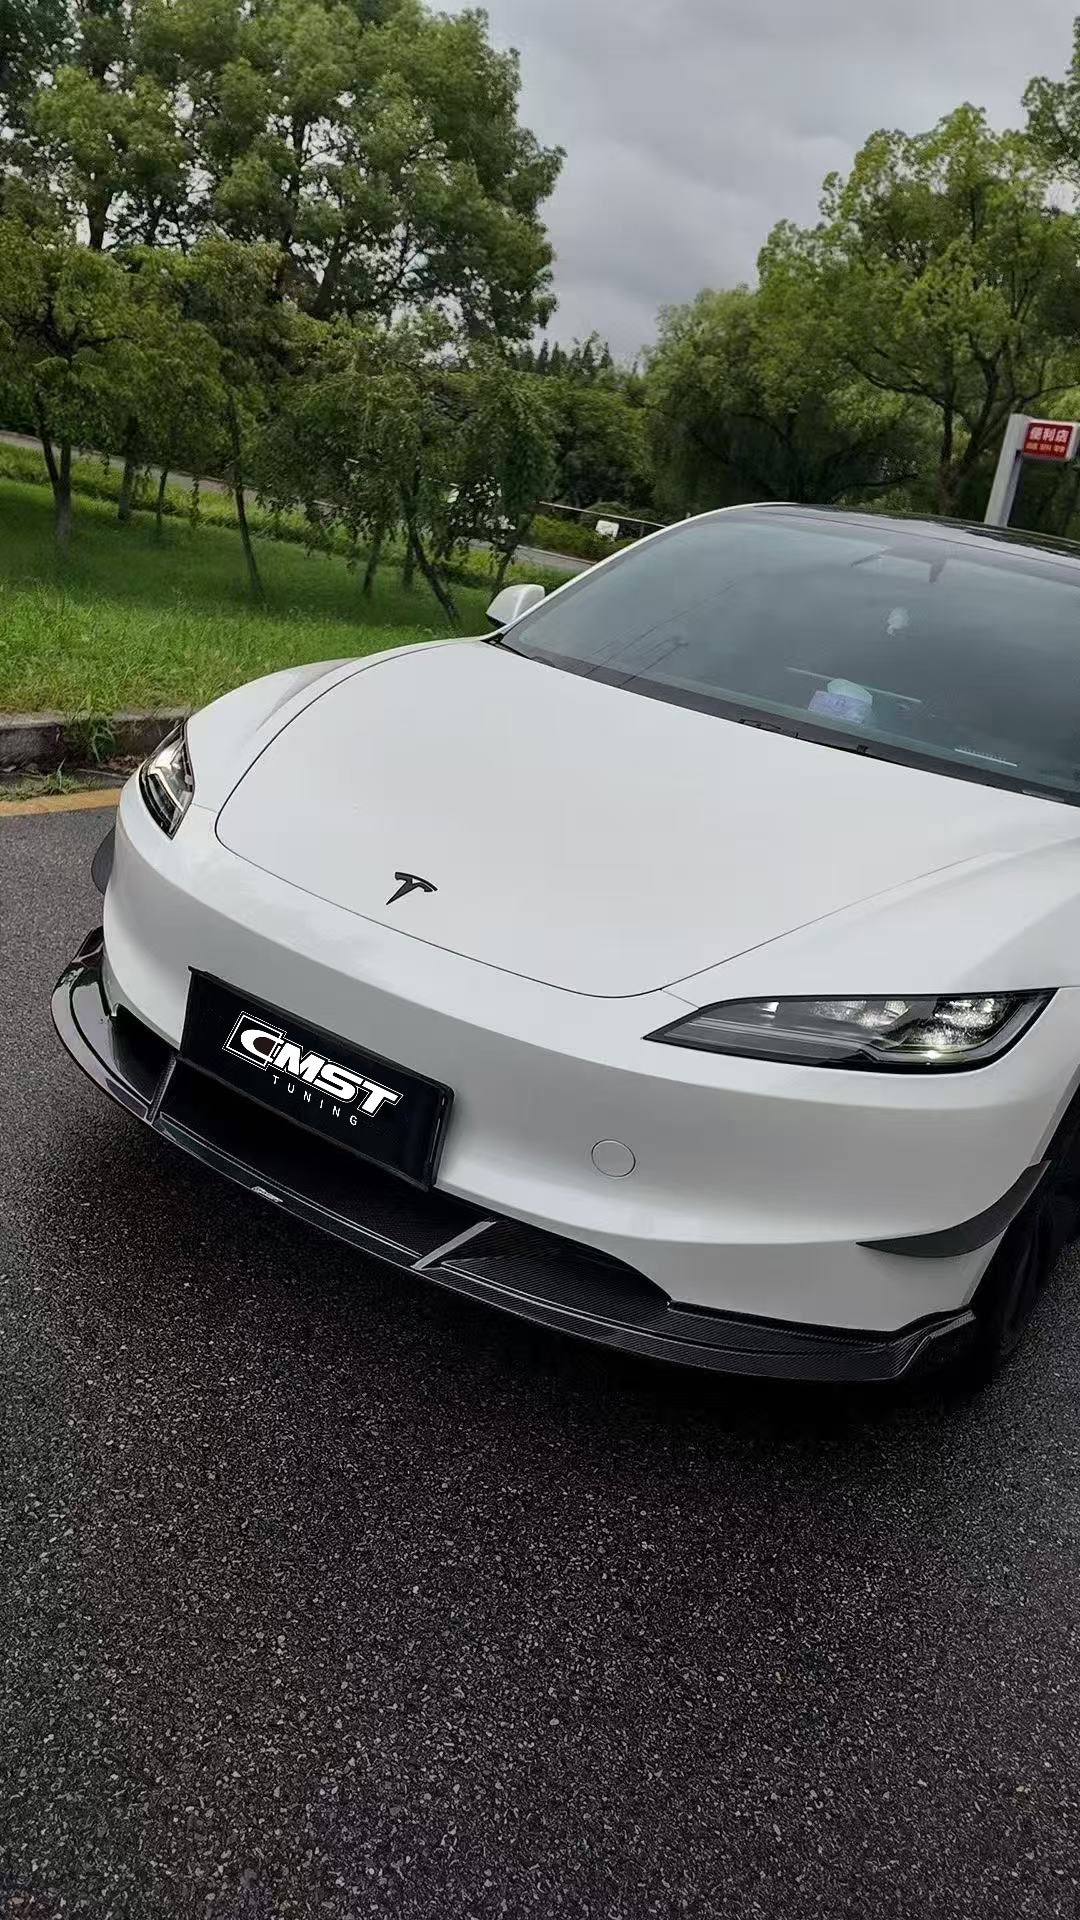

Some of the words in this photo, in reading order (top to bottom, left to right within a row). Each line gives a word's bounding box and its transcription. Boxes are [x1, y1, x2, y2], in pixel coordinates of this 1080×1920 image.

[1029, 426, 1069, 443] 便利店
[236, 1024, 401, 1115] CMST
[272, 1074, 358, 1126] TUNING
